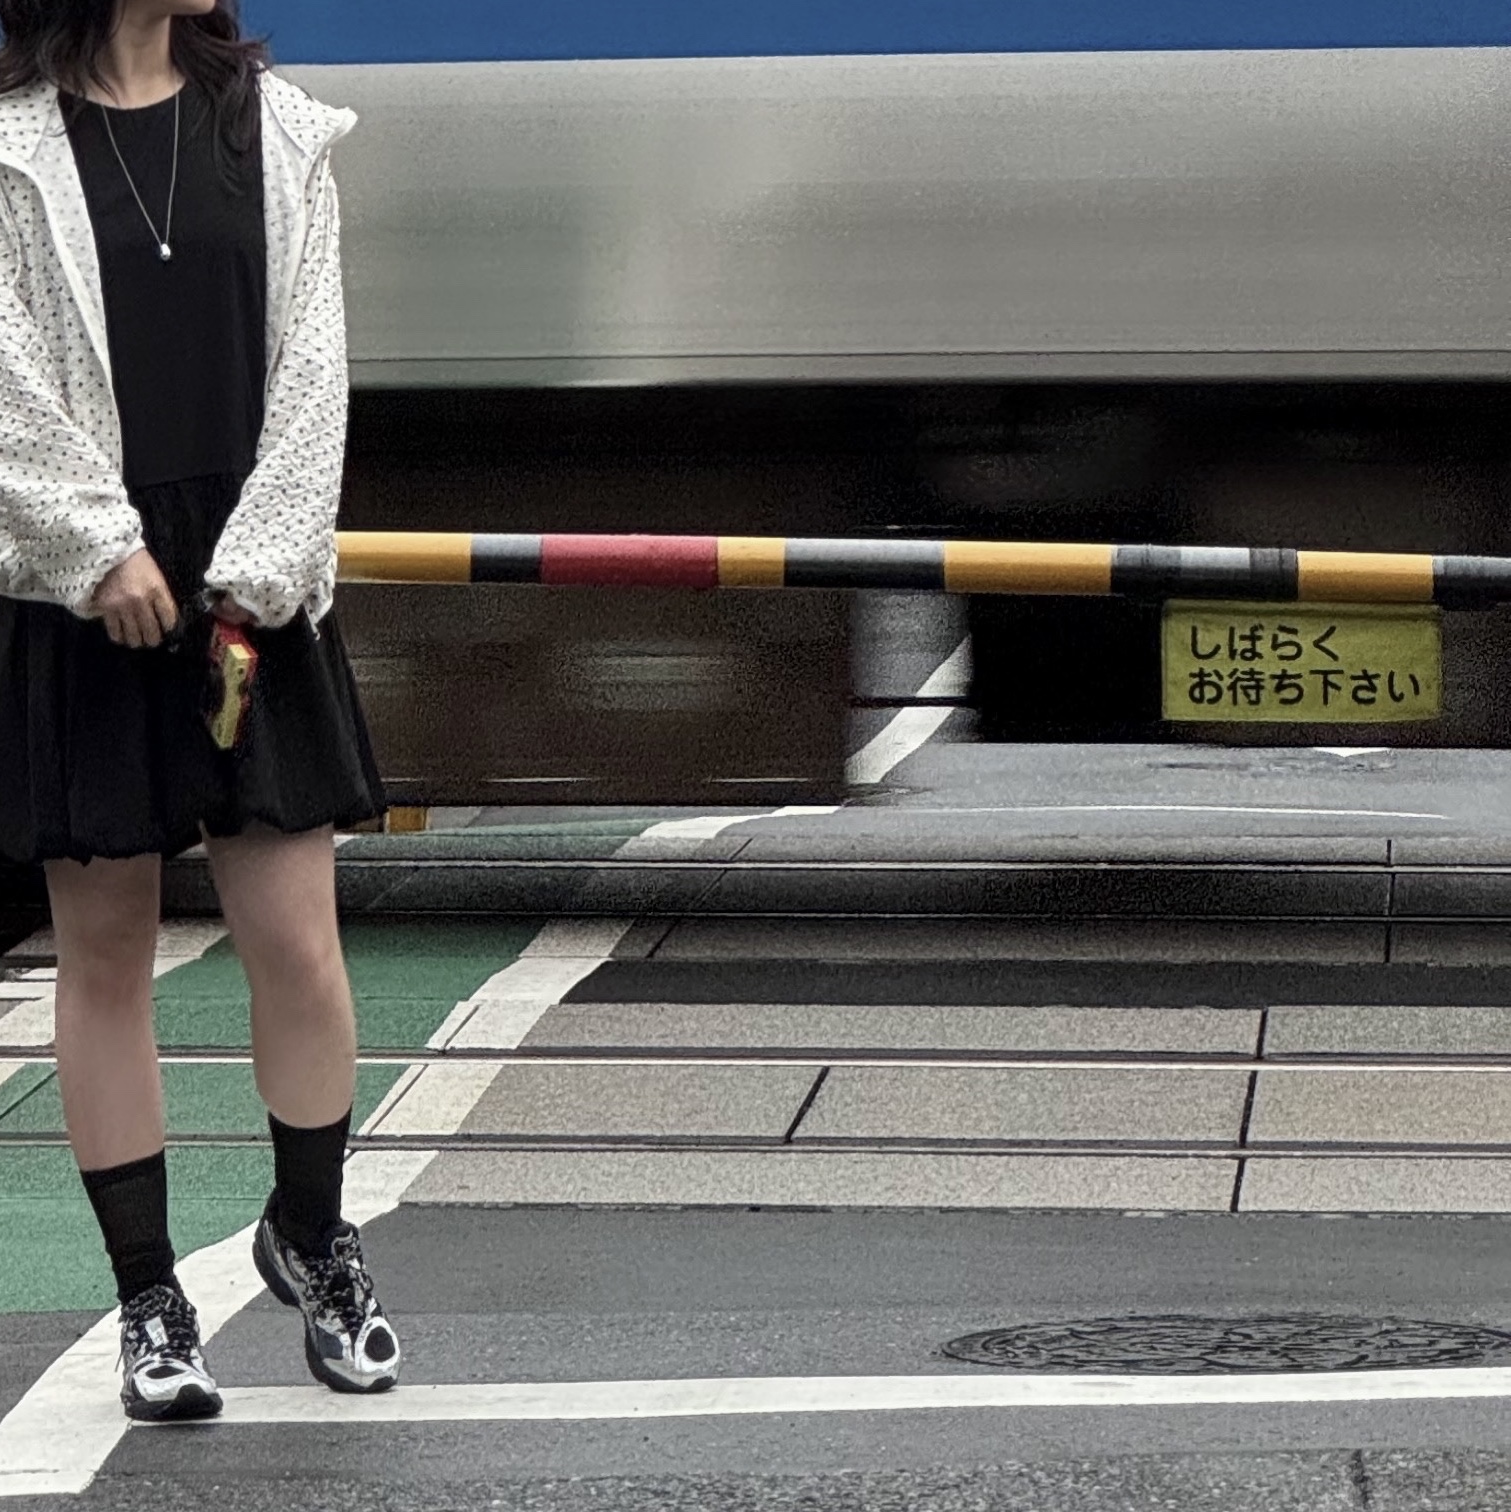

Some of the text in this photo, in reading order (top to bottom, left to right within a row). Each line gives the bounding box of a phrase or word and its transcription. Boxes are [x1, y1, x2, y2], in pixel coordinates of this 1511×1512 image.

[1190, 623, 1339, 662] しばらく
[1188, 667, 1420, 706] お待ち下さい
